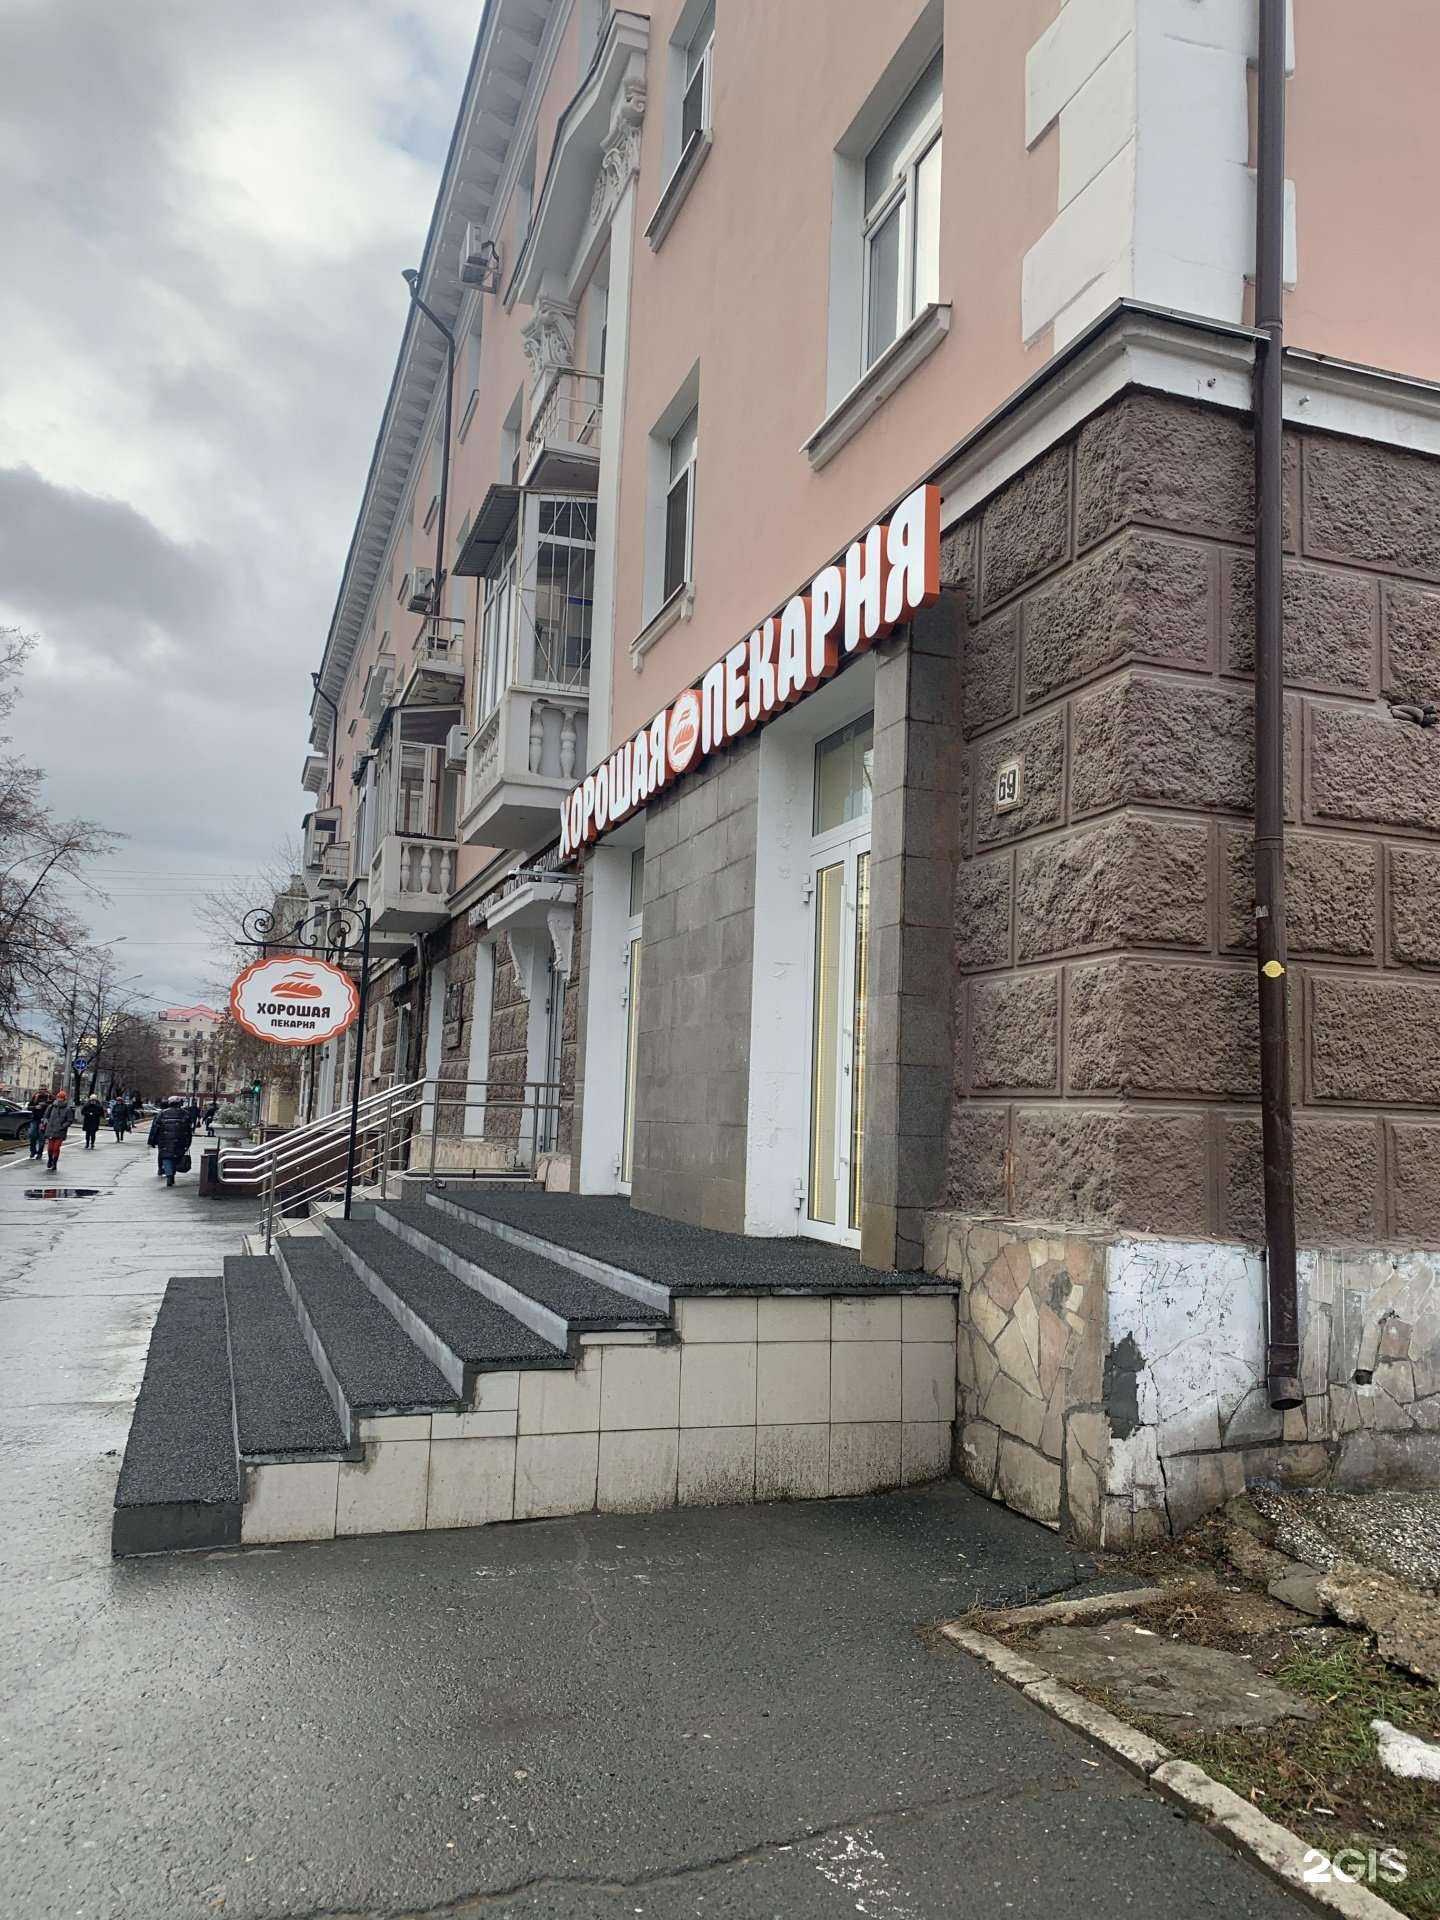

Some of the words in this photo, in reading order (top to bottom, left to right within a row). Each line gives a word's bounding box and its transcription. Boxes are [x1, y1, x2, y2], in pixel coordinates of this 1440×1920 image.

[559, 709, 667, 859] ХОРОШАЯ
[702, 484, 928, 755] ПЕКАРНЯ
[257, 1003, 331, 1018] ХОРОШАЯ
[270, 1019, 316, 1029] ПЕКАРНЯ
